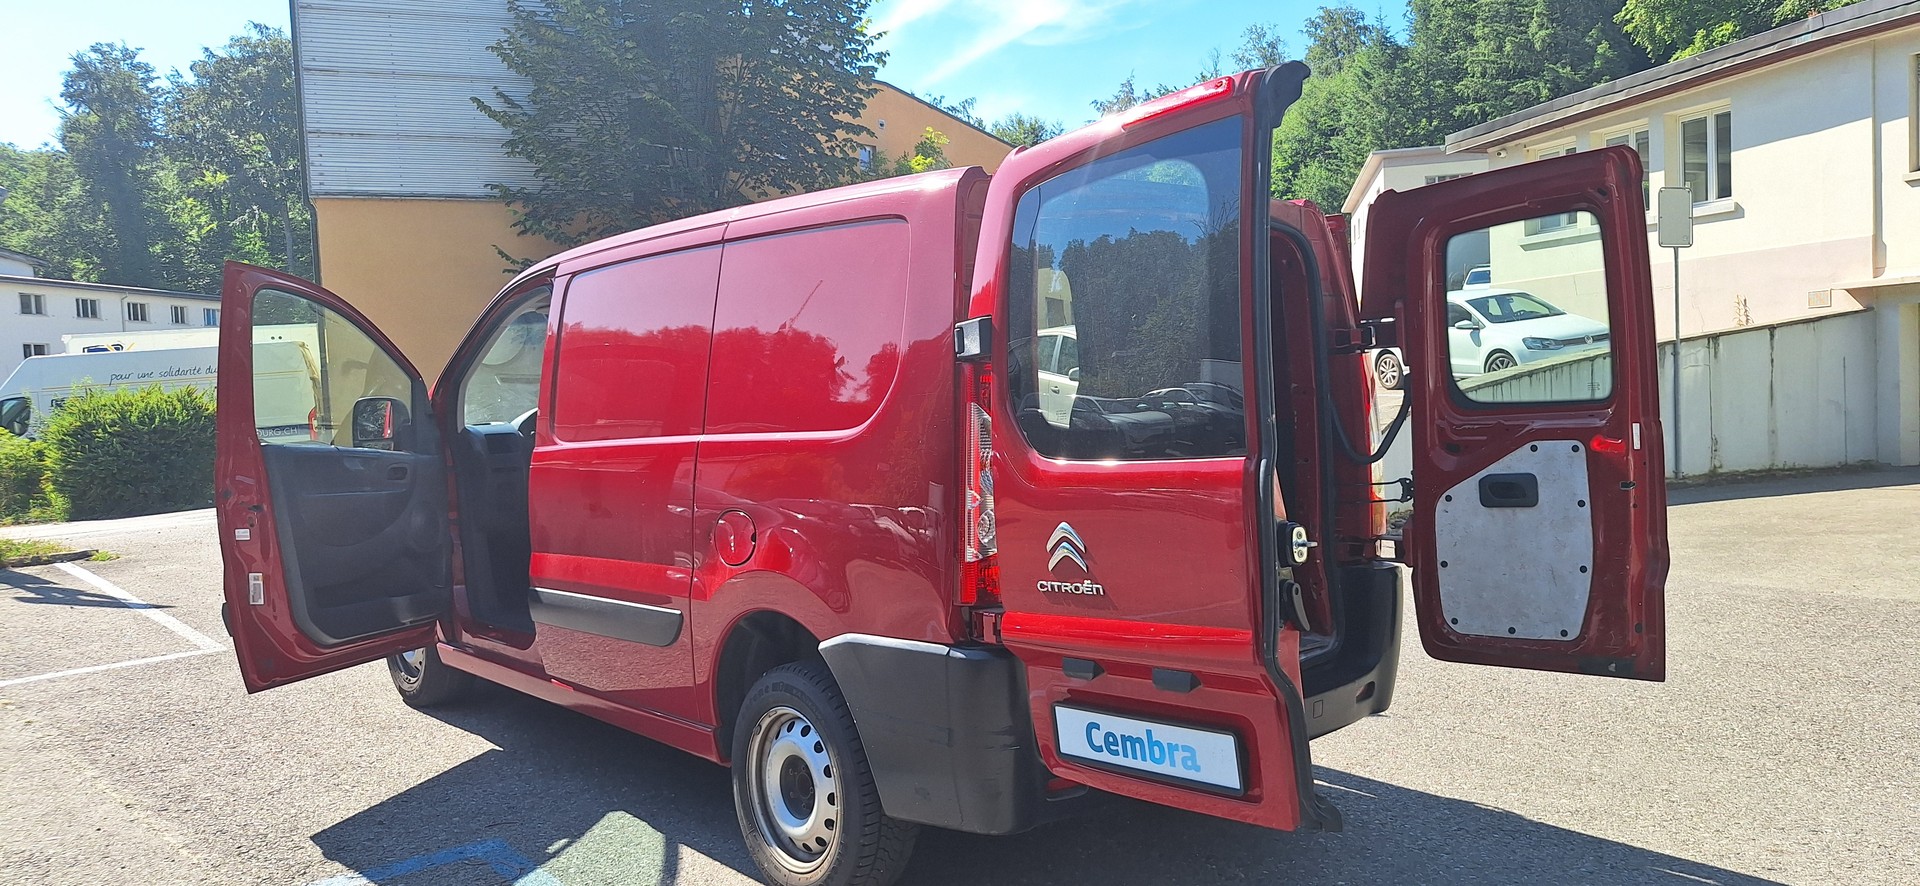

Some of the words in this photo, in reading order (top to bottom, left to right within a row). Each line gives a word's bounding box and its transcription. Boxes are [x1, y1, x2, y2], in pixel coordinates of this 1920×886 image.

[109, 372, 134, 387] pour
[137, 371, 154, 379] une
[1085, 721, 1201, 772] Cembra
